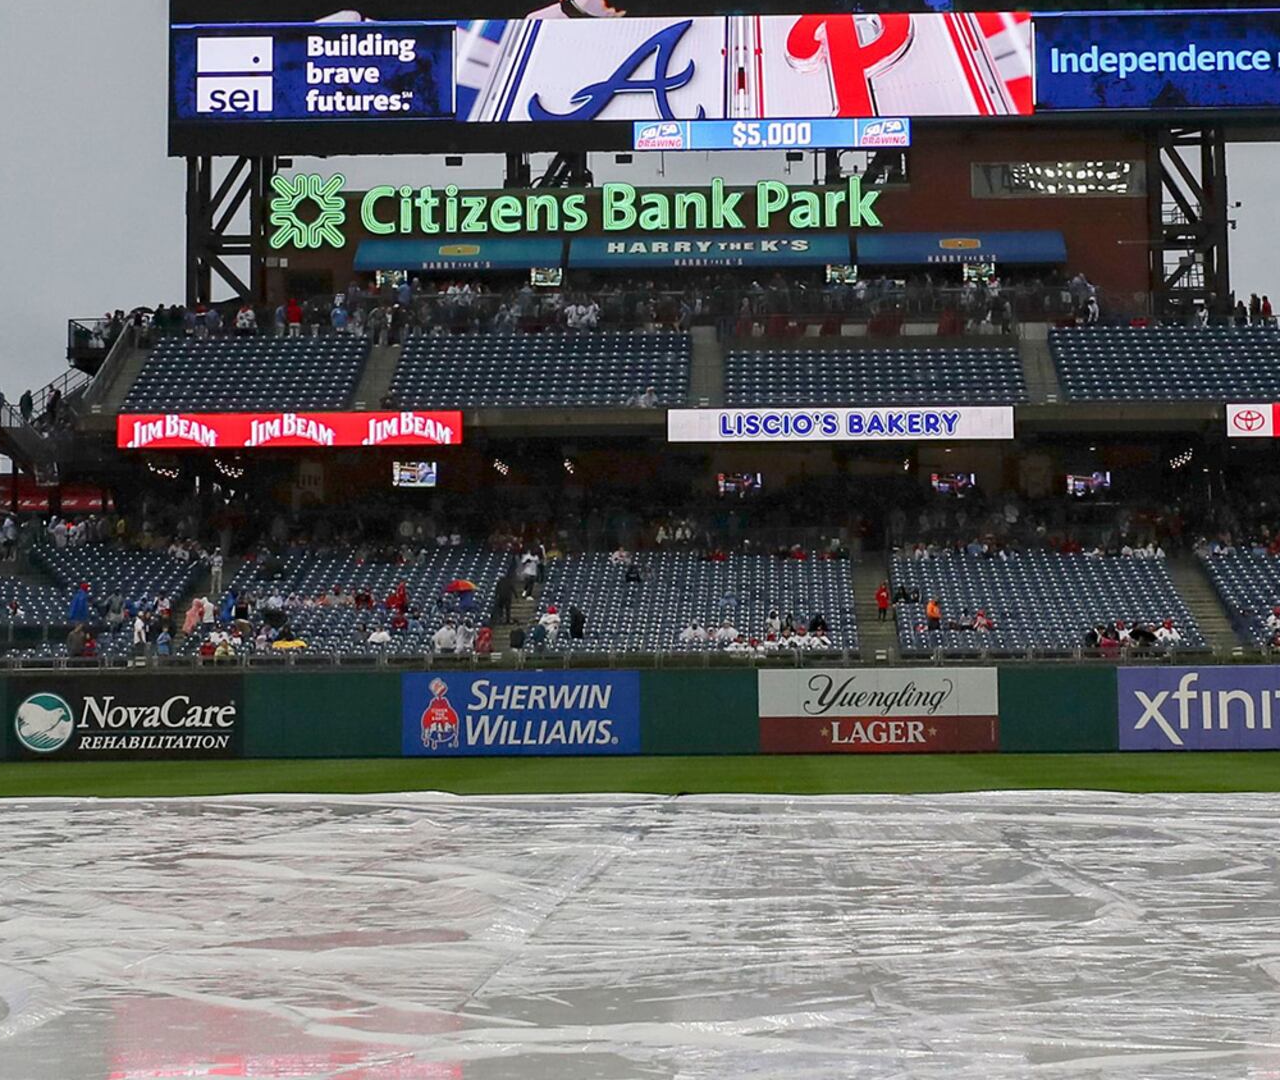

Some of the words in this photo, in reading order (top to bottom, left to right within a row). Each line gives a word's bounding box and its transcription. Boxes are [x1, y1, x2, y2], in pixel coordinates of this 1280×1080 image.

[306, 33, 416, 62] Building
[1050, 44, 1271, 78] Independence
[306, 62, 380, 85] brave
[641, 124, 679, 138] 50/50
[732, 121, 812, 148] $5,000
[861, 134, 906, 146] DRAWING
[863, 121, 902, 136] 50/50
[637, 138, 682, 149] DRAWING
[360, 182, 587, 235] Citizens
[602, 175, 744, 231] Bank
[755, 174, 883, 229] Park
[607, 239, 713, 254] HARRY
[718, 241, 755, 252] THE
[760, 238, 809, 252] K'S
[127, 421, 164, 447] JIM
[164, 414, 218, 447] BEAM
[244, 420, 281, 446] JIM
[281, 413, 336, 446] BEAM
[362, 418, 400, 445] JIM
[399, 411, 454, 445] BEAM
[720, 411, 839, 437] LISCIO'S
[847, 410, 961, 436] BAKERY
[467, 679, 613, 711] SHERWIN
[803, 674, 953, 716] Yuengling
[77, 695, 233, 729] NovaCare
[78, 733, 230, 752] REHABILITATION
[831, 720, 927, 744] LAGER
